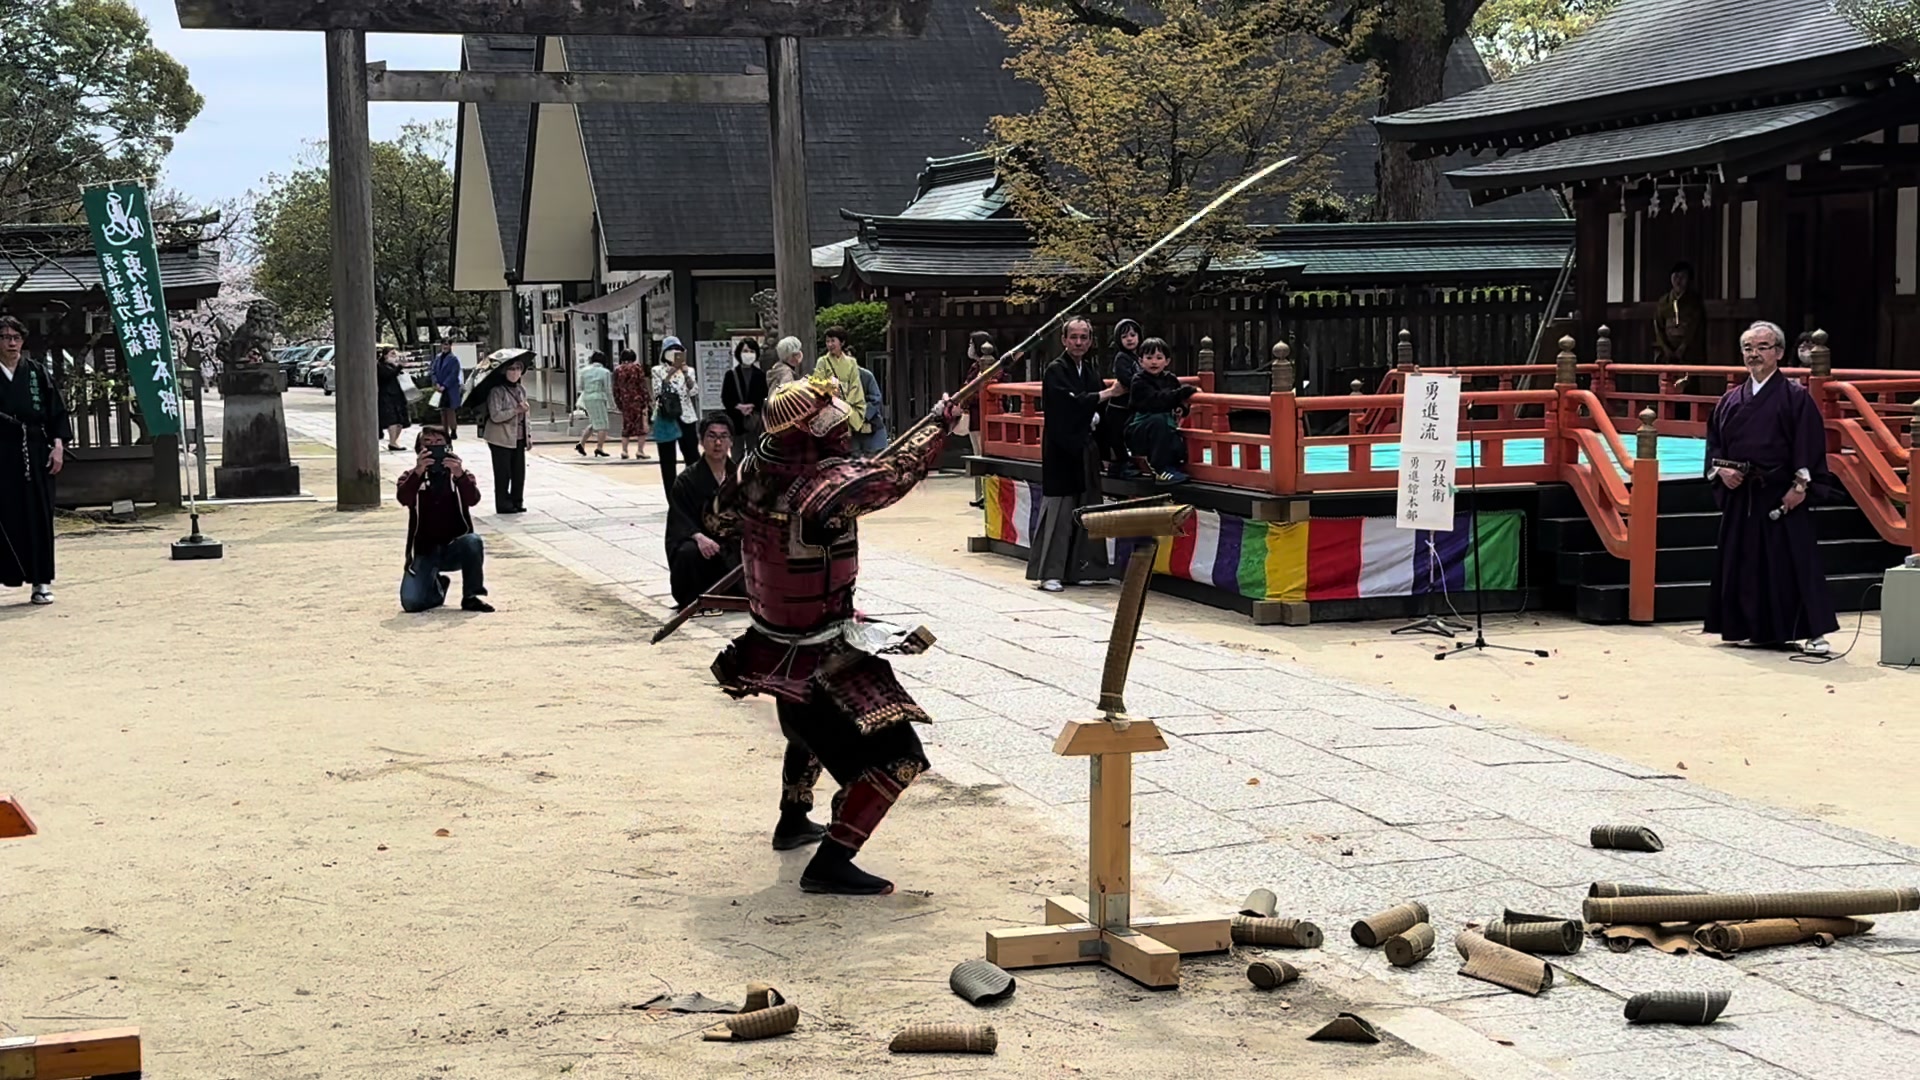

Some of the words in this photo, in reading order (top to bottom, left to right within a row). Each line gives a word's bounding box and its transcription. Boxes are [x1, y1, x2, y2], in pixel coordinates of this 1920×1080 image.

[1419, 381, 1440, 441] 勇進流
[1431, 459, 1447, 503] 刀技術
